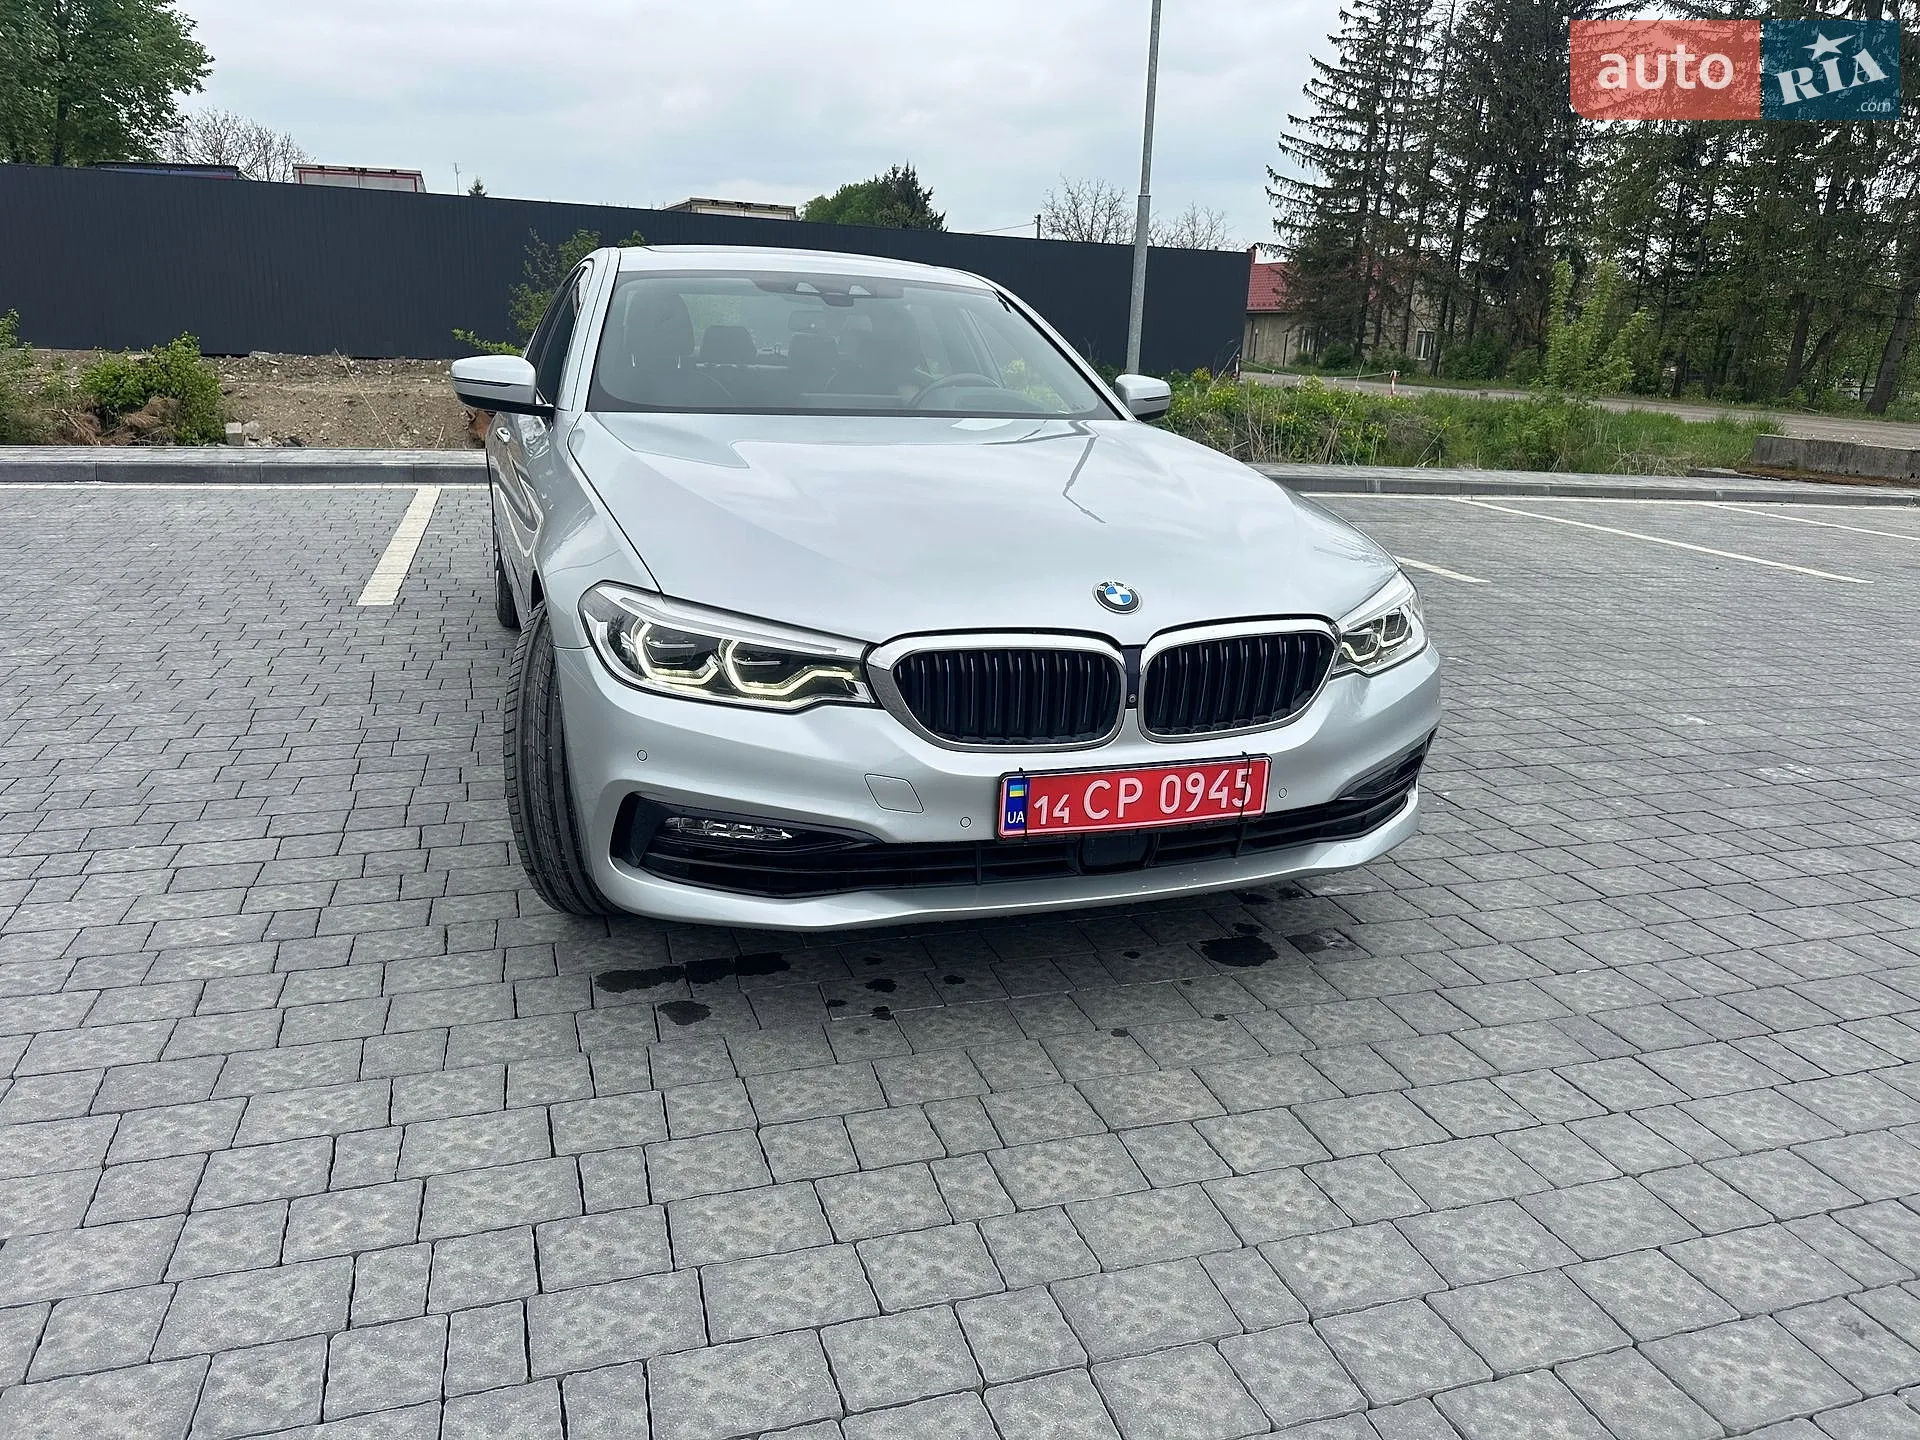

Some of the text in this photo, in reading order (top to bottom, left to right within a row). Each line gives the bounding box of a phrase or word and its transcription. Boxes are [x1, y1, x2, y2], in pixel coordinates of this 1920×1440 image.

[1033, 768, 1253, 825] 14 CP 0945
[1007, 811, 1025, 824] UA
